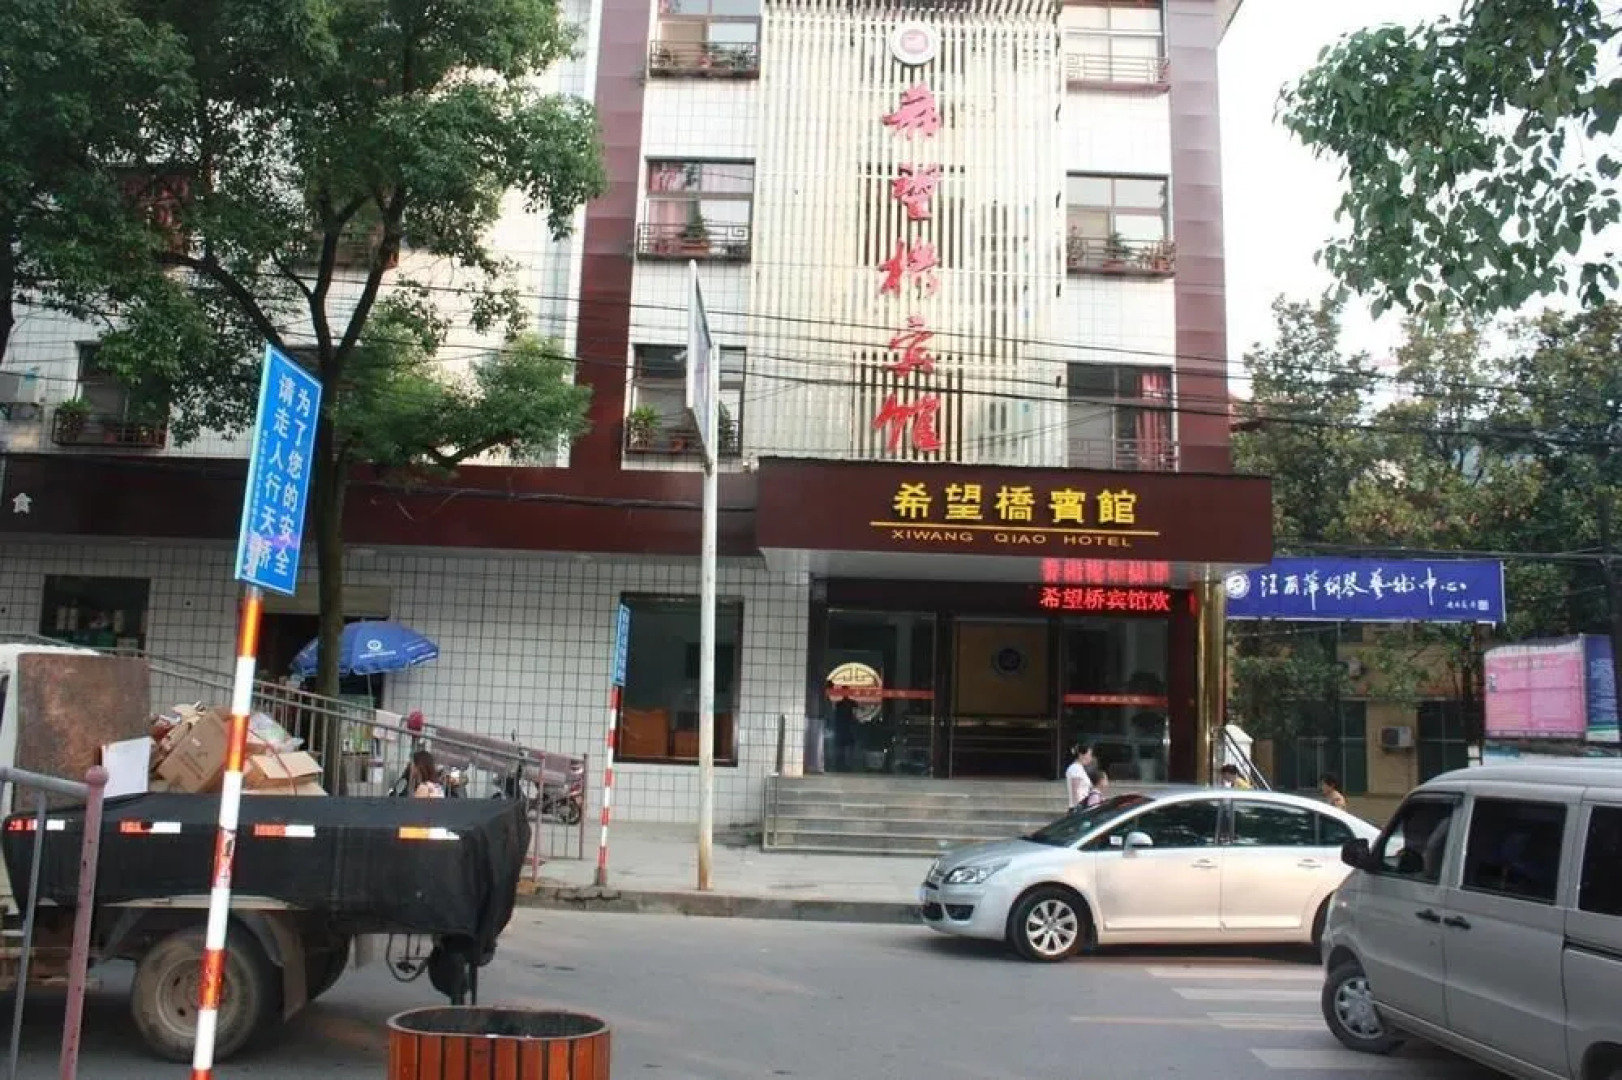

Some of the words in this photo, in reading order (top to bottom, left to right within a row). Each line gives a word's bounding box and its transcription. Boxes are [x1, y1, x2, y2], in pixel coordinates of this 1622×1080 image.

[273, 388, 311, 576] 为了您的安全
[893, 482, 1137, 525] 希望橋賓館
[891, 529, 975, 543] XIWANG
[993, 533, 1048, 545] QIAO
[1063, 534, 1133, 548] HOTEL
[1040, 586, 1171, 612] 希望桥宾馆欢
